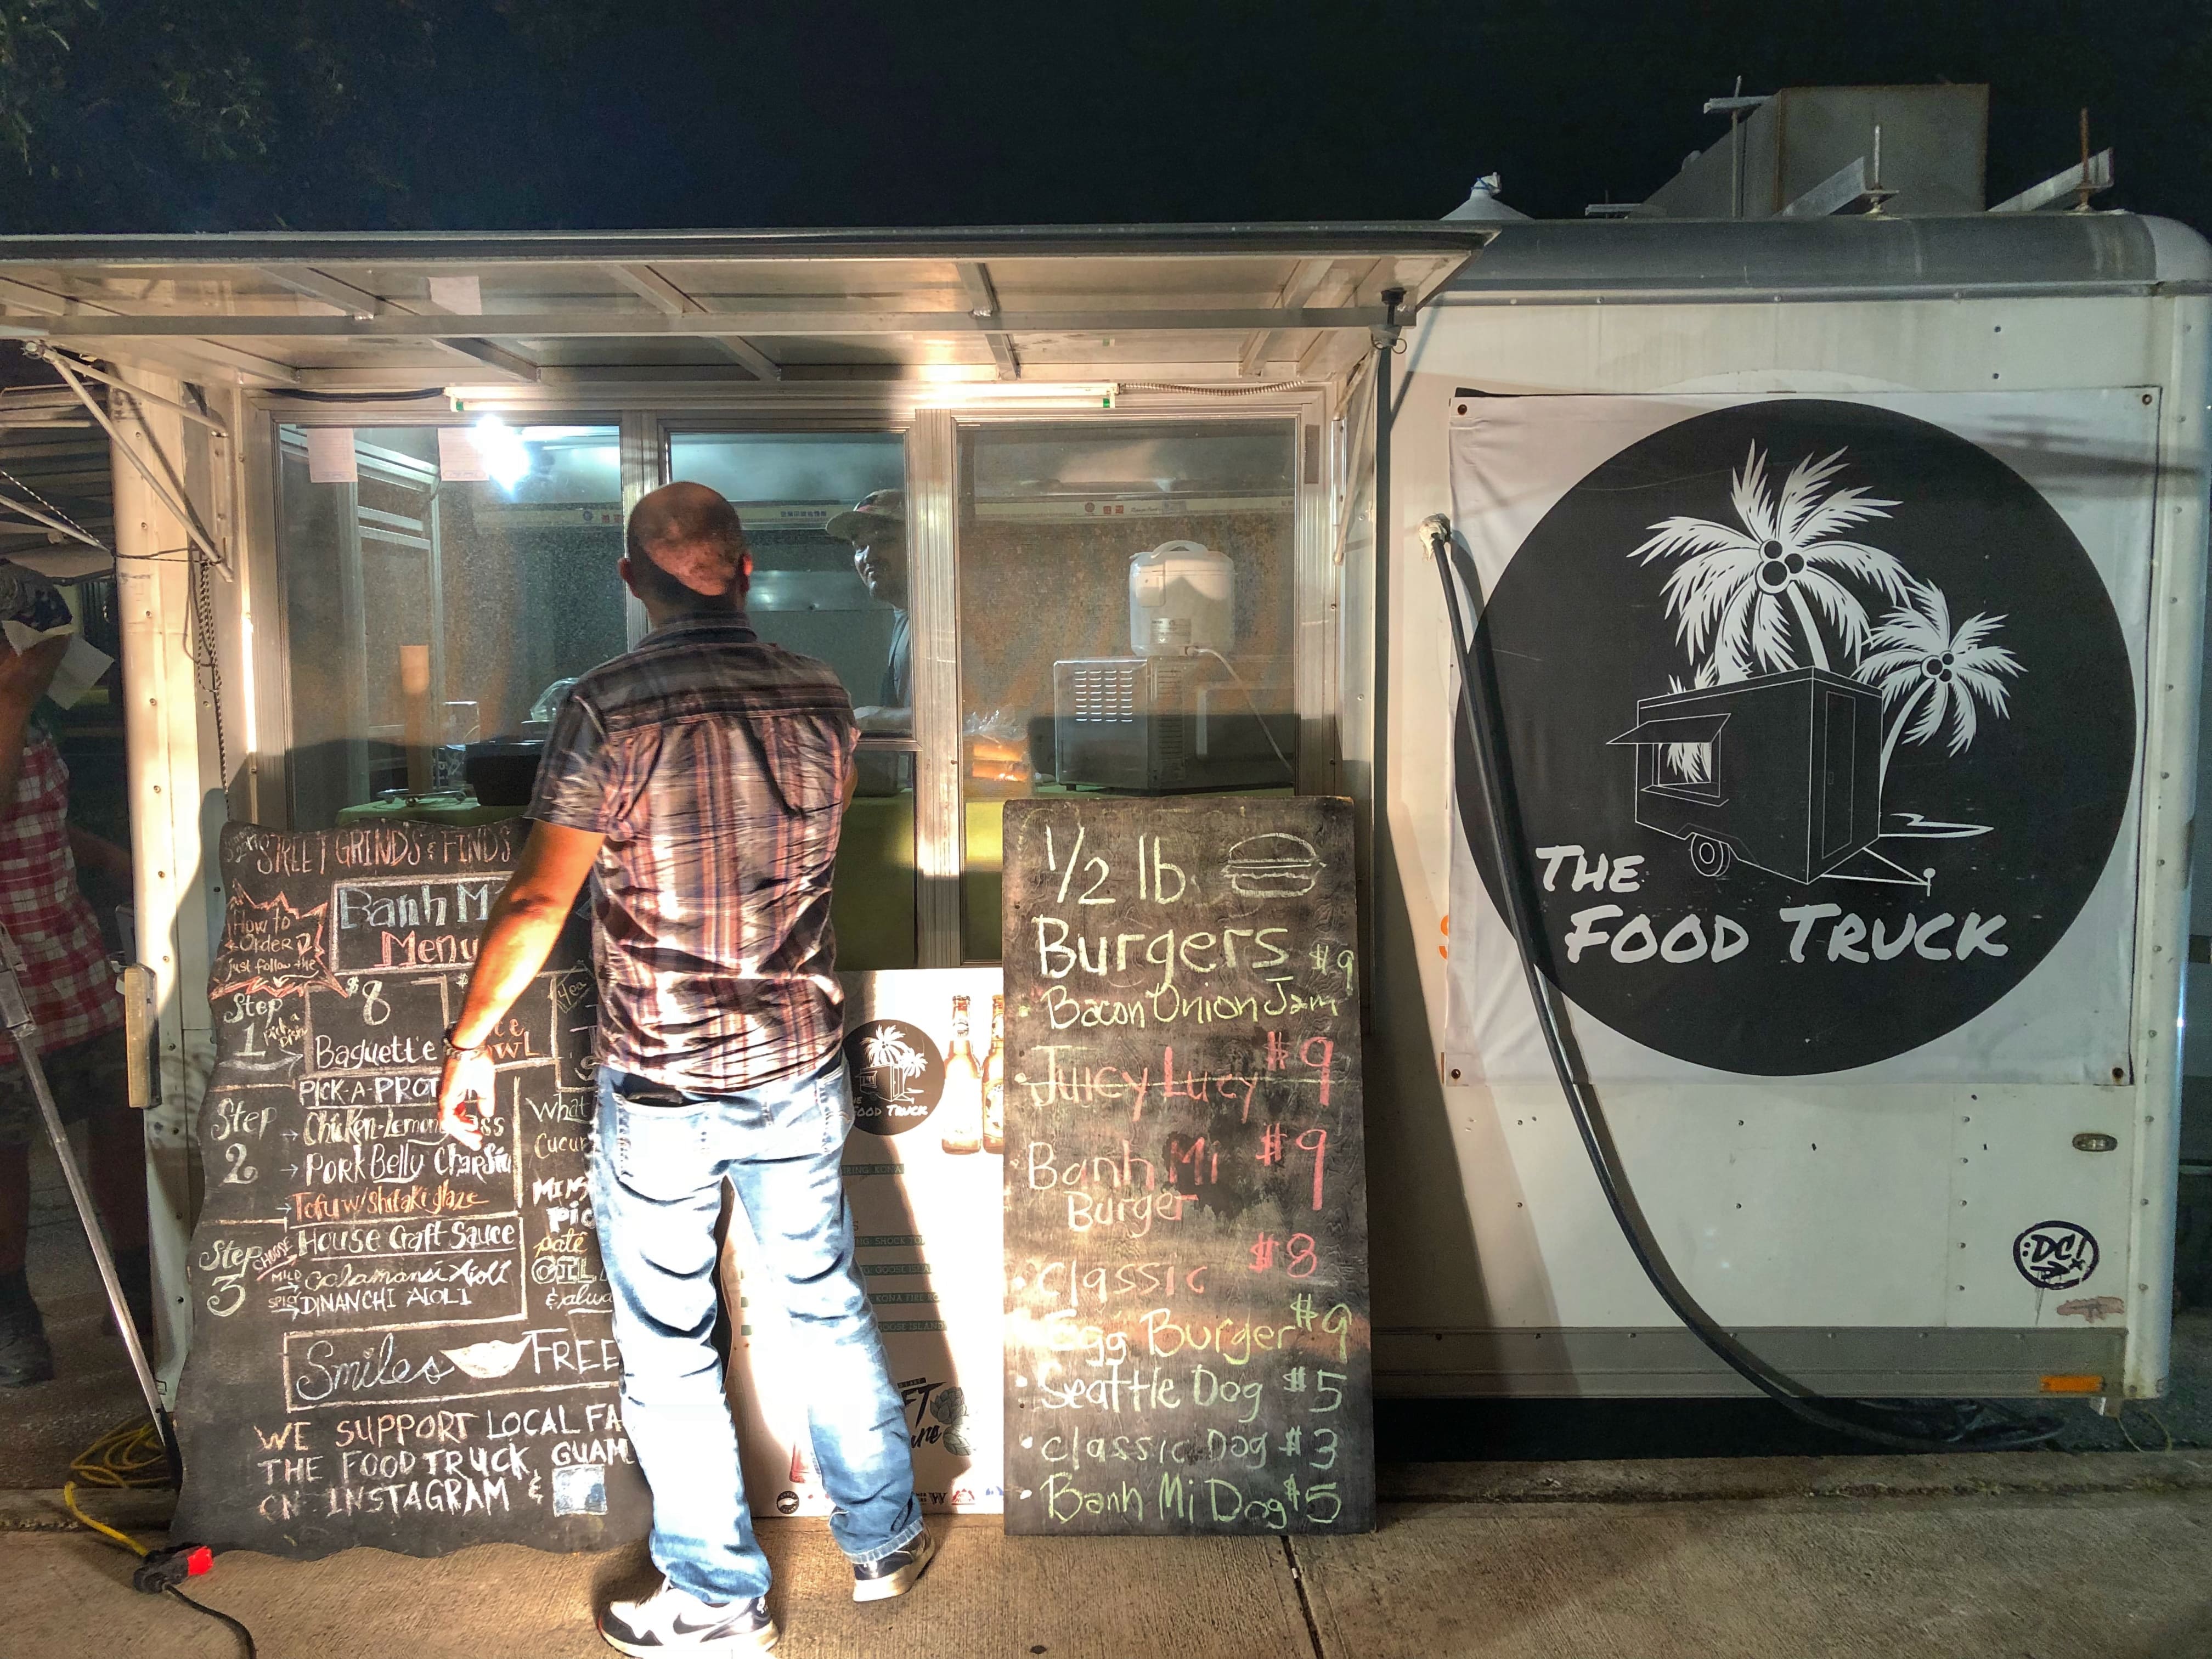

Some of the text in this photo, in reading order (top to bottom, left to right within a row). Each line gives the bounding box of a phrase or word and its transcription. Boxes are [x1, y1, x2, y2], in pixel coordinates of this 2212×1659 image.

[257, 833, 329, 877] STREET
[335, 829, 421, 868] GRINDS
[427, 839, 436, 860] &
[443, 827, 512, 865] FINDS
[1046, 822, 1116, 905] 1/2
[1536, 844, 1645, 893] THE
[272, 907, 291, 934] to
[340, 882, 504, 930] Banh M
[374, 930, 478, 967] Menu
[1031, 912, 1355, 996] Burgers $9
[1566, 902, 2010, 964] FOOD TRUCK
[225, 957, 317, 982] just follow the
[223, 992, 283, 1029] Step
[1041, 976, 1339, 1030] Bacon Onion Jam
[232, 1022, 266, 1057] 1
[315, 1035, 438, 1072] Baguette
[1163, 1046, 1260, 1124] Lucy
[1265, 1031, 1334, 1107] $9
[211, 1097, 277, 1142] Step
[886, 1104, 929, 1117] TRUCK
[221, 1143, 258, 1185] 2
[370, 1143, 424, 1183] Belly
[1028, 1121, 1328, 1211] Banh Mi $9
[291, 1192, 340, 1222] Tofu
[431, 1179, 490, 1215] glaze
[1063, 1189, 1199, 1239] Burger
[200, 1239, 263, 1278] Step
[252, 1236, 294, 1271] CHOOSE
[298, 1222, 514, 1256] House Craft Sauce
[875, 1237, 905, 1245] SHOCK
[1250, 1231, 1318, 1279] $8
[207, 1275, 246, 1317] 3
[272, 1269, 302, 1283] MILD
[406, 1287, 473, 1308] AIOLI
[876, 1294, 902, 1302] KONA
[1139, 1307, 1296, 1365] Burger
[1291, 1292, 1353, 1364] $9
[296, 1328, 619, 1401] Smiles FREE
[1036, 1363, 1347, 1424] Seattle Dog $5
[254, 1421, 312, 1452] WE
[335, 1410, 479, 1449] SUPPORT
[486, 1408, 580, 1442] LOCAL
[1207, 1428, 1269, 1470] Dog
[1278, 1425, 1339, 1470] $3
[257, 1455, 324, 1485] THE
[342, 1451, 417, 1483] FOOD
[427, 1442, 534, 1481] TRUCK
[327, 1476, 510, 1517] INSTAGRAM
[1040, 1471, 1342, 1530] Banh Mi Dog $5
